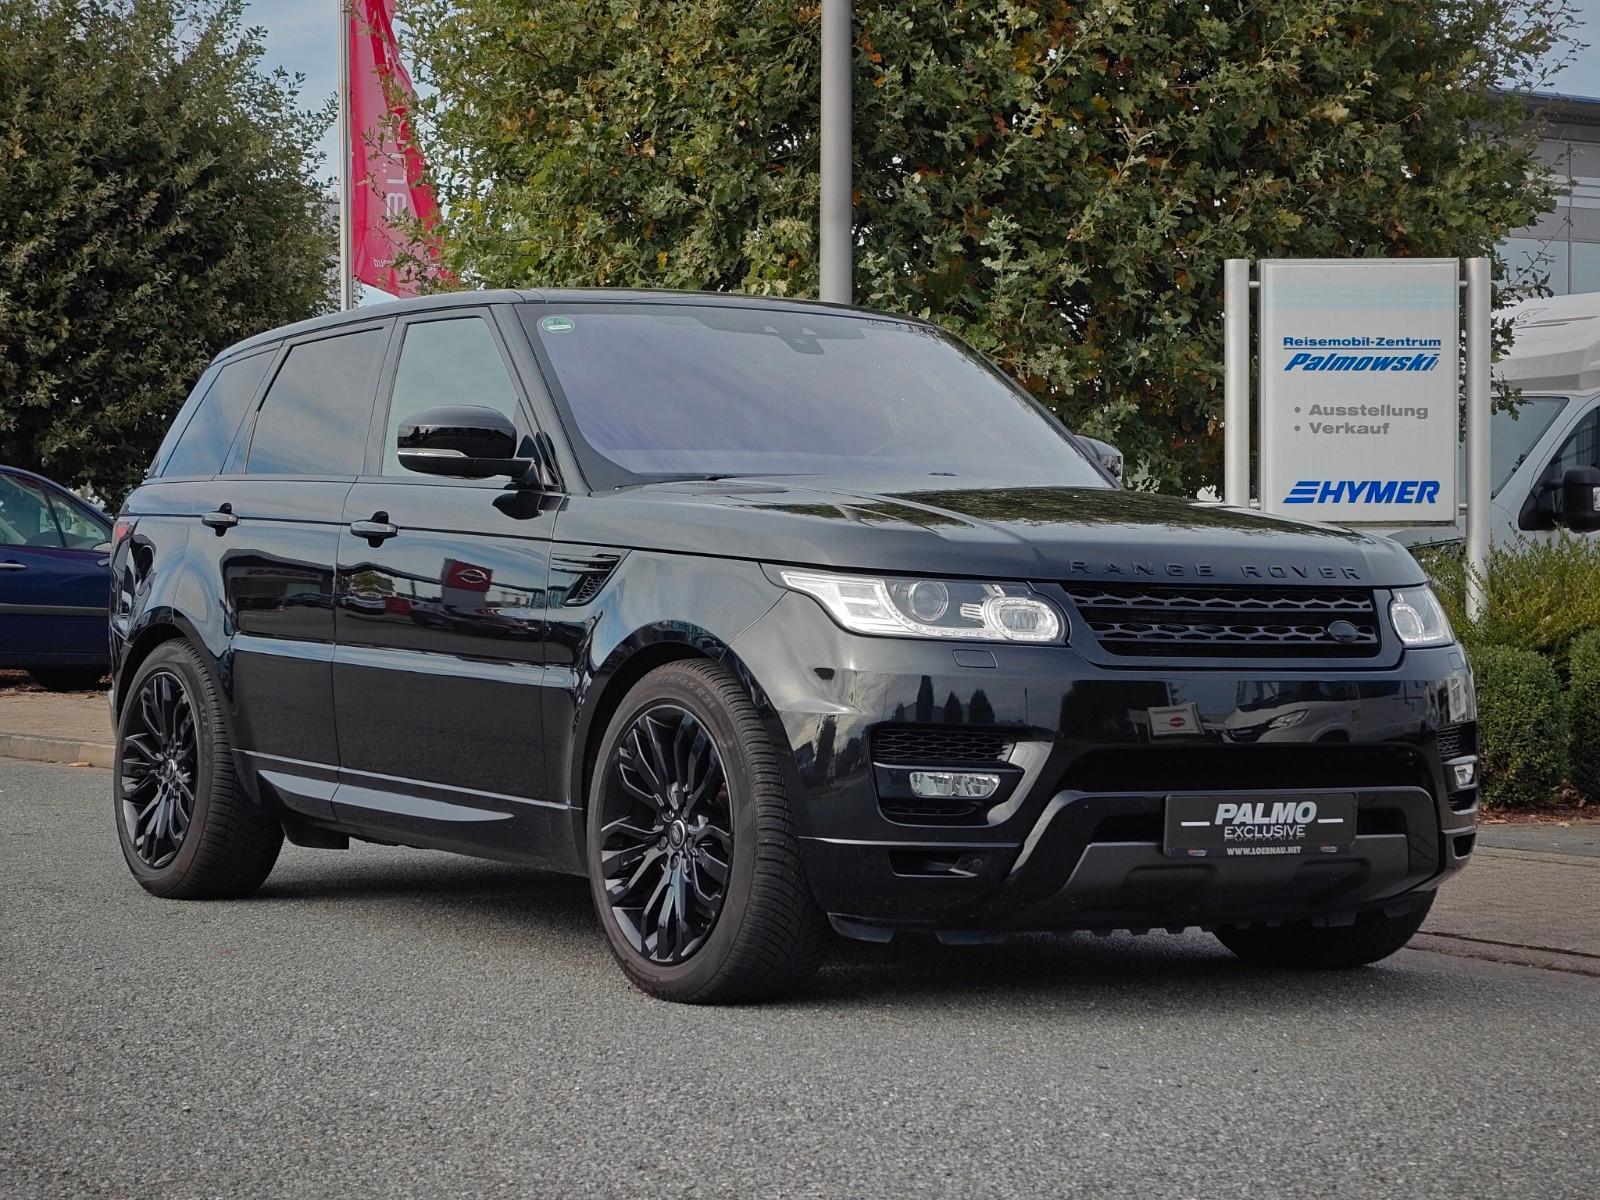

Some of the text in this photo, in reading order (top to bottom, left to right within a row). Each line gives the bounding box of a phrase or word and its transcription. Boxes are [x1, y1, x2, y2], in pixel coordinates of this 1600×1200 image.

[1283, 337, 1441, 347] Reisemobil-Zentrum
[1284, 353, 1440, 371] Palmowski
[1309, 404, 1429, 420] Ausstellung
[1309, 422, 1390, 435] Verkauf
[1317, 481, 1440, 504] HYMER
[1068, 559, 1361, 579] RANGE ROVER
[1214, 801, 1318, 825] PALMO
[1224, 825, 1306, 838] EXCLUSIVE
